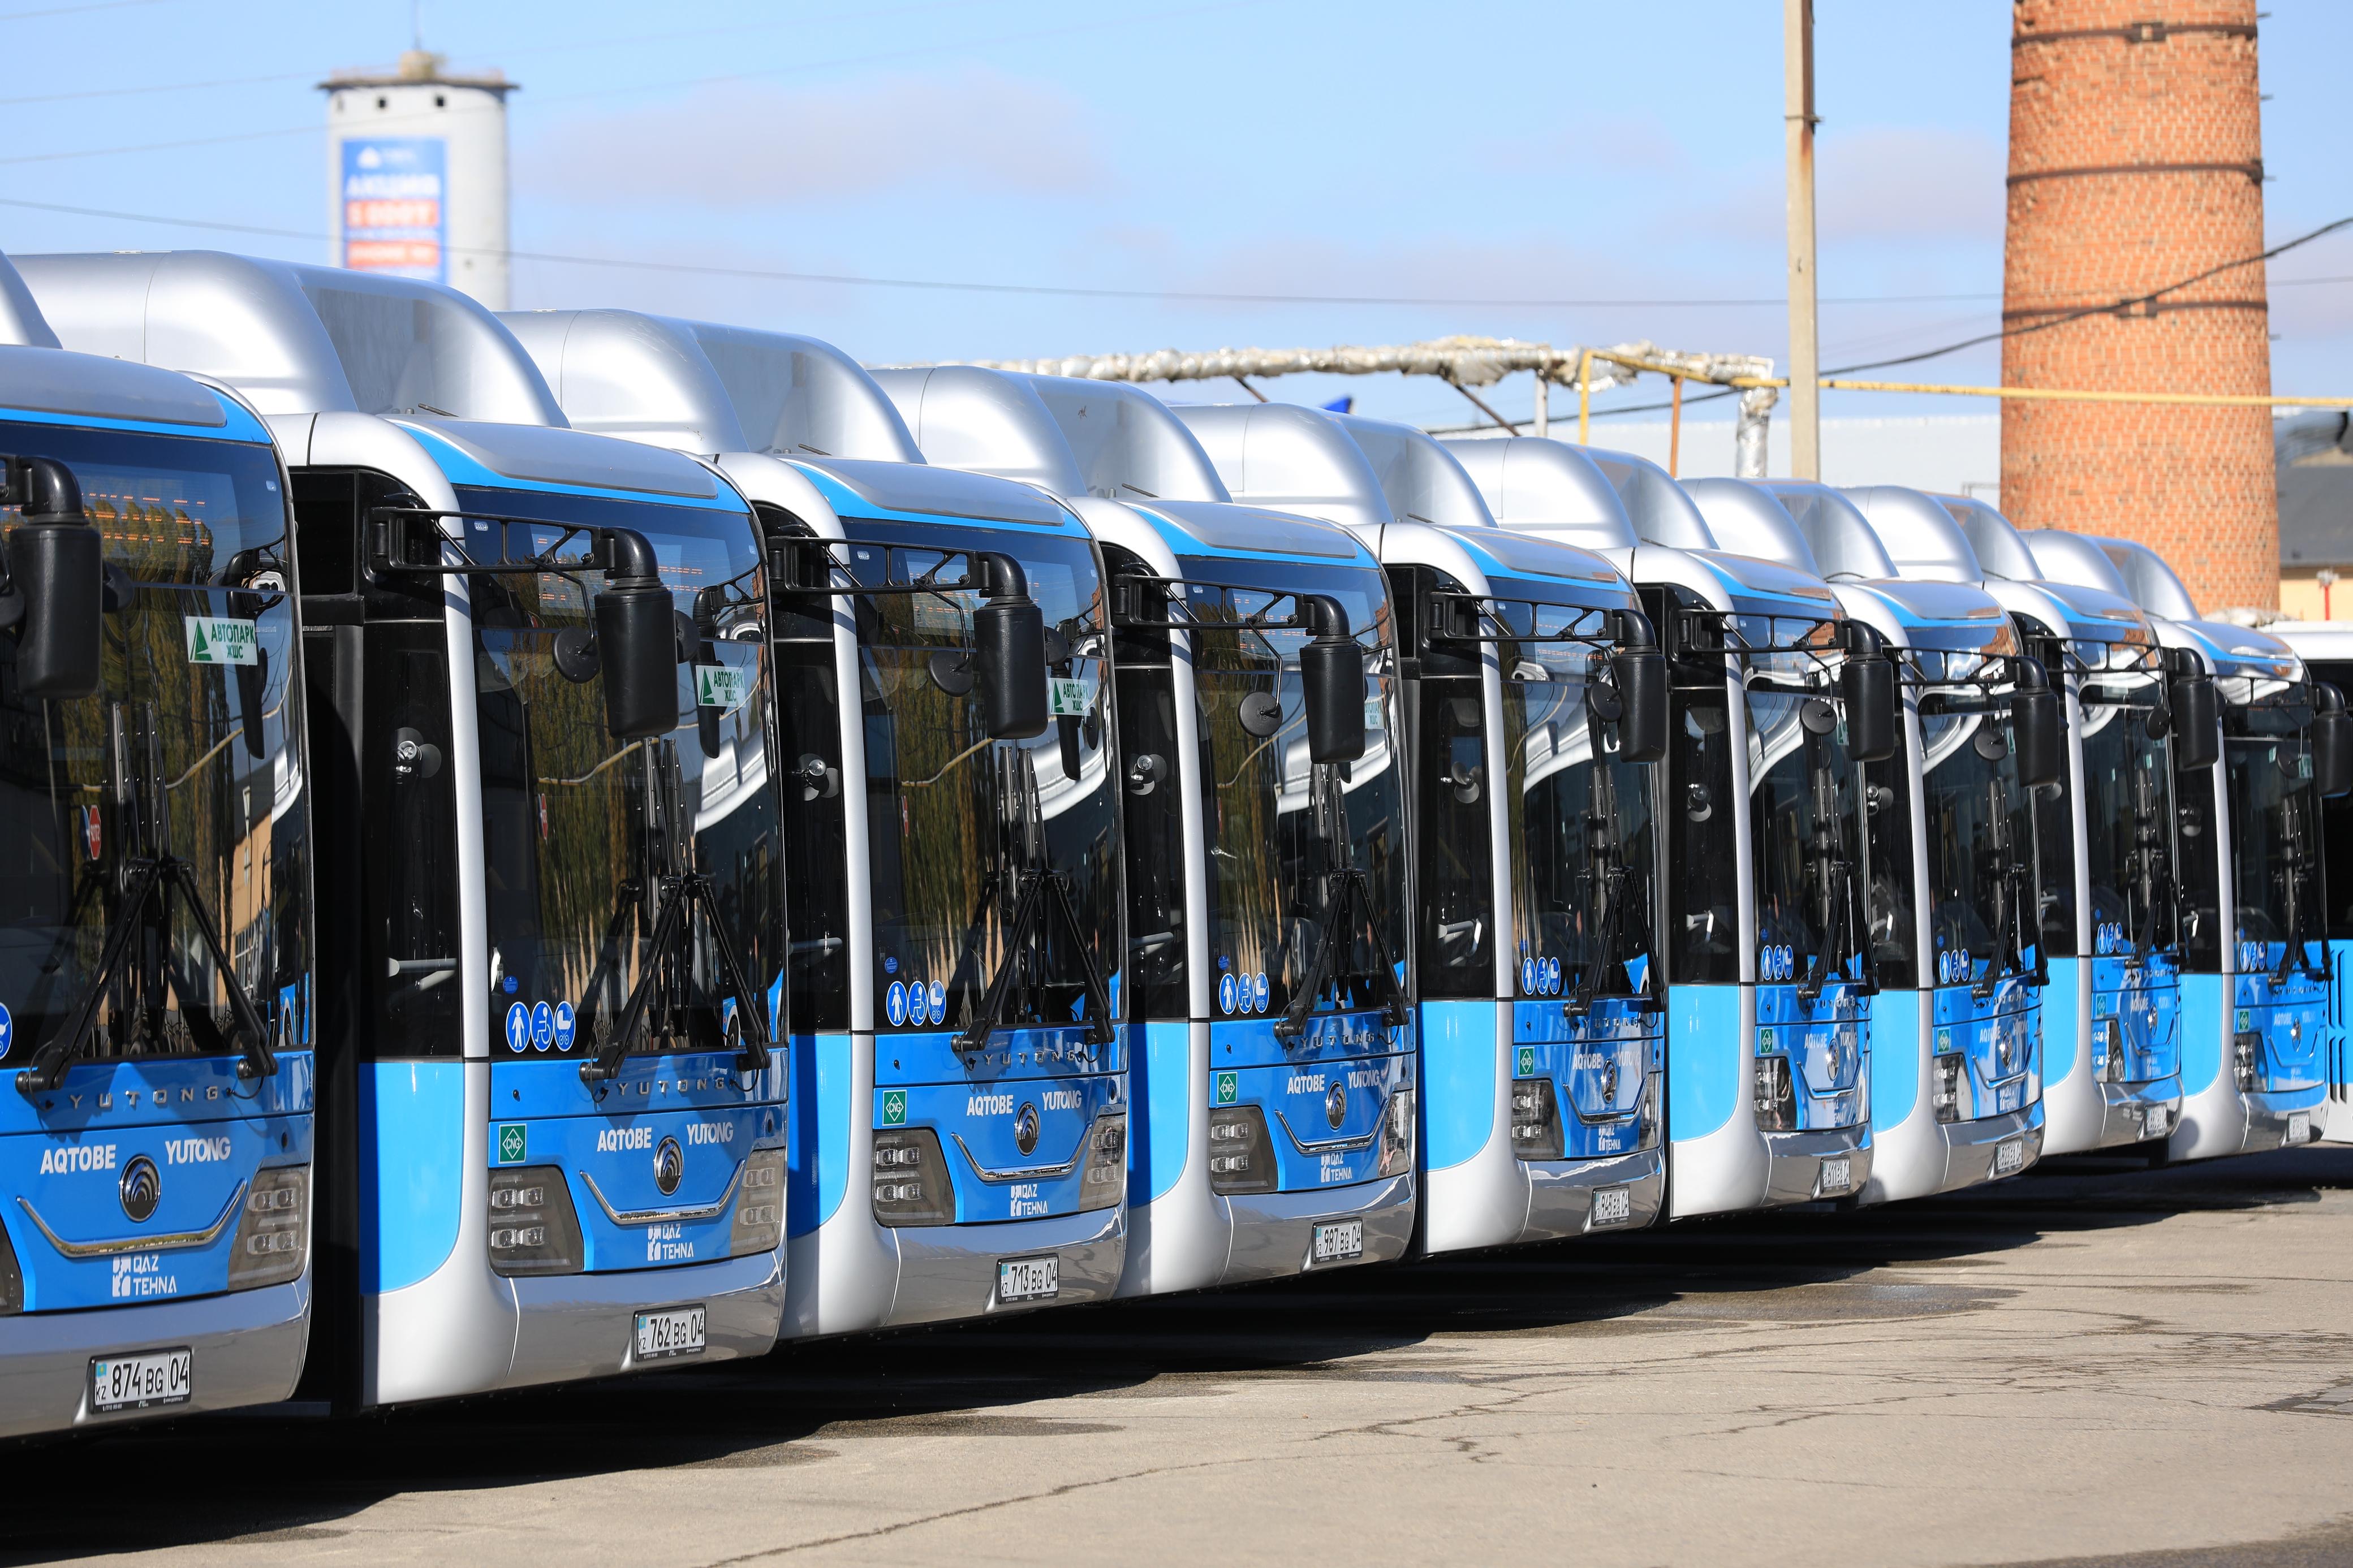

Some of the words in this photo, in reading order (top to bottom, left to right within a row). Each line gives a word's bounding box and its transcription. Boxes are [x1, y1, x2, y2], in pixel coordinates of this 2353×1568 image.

[211, 623, 256, 643] АВТОПАРК
[227, 645, 243, 659] ЖШС
[714, 671, 744, 688] АВТОПАРК
[1063, 683, 1089, 699] АВТОПАРК
[1300, 1033, 1374, 1046] YUTONG
[1804, 1033, 1827, 1049] AQTOBE
[984, 1049, 1075, 1066] YUTONG
[1573, 1053, 1602, 1070] AQTOBE
[619, 1077, 724, 1095] YUTONG
[1223, 1083, 1232, 1092] CNG
[1287, 1074, 1325, 1095] AQTOBE
[1348, 1069, 1380, 1088] YUTONG
[70, 1086, 218, 1108] YUTONG
[967, 1095, 1013, 1117] AQTOBE
[1042, 1090, 1081, 1111] YUTONG
[889, 1103, 900, 1113] CNG
[506, 1138, 520, 1150] CNG
[597, 1127, 652, 1152] AQTOBE
[687, 1122, 733, 1145] YUTONG
[40, 1144, 116, 1174] AQTOBE
[165, 1137, 230, 1164] YUTONG
[1331, 1152, 1343, 1166] QAZ
[1331, 1167, 1352, 1181] TEHNA
[1023, 1183, 1037, 1199] QAZ
[1022, 1200, 1048, 1216] TEHNA
[663, 1224, 680, 1241] QAZ
[1324, 1228, 1338, 1253] 987
[1340, 1232, 1348, 1251] BG
[1352, 1224, 1360, 1249] 04
[662, 1242, 693, 1260] TEHNA
[133, 1254, 159, 1274] QAZ
[133, 1276, 176, 1295] TEHNA
[1011, 1265, 1029, 1293] 713
[1031, 1269, 1042, 1290] BG
[1046, 1262, 1056, 1288] 04
[650, 1317, 670, 1349] 762
[674, 1322, 686, 1346] BG
[691, 1312, 703, 1342] 04
[96, 1385, 106, 1401] KZ
[113, 1362, 141, 1398] 874
[145, 1367, 163, 1394] BG
[170, 1356, 188, 1390] 04
